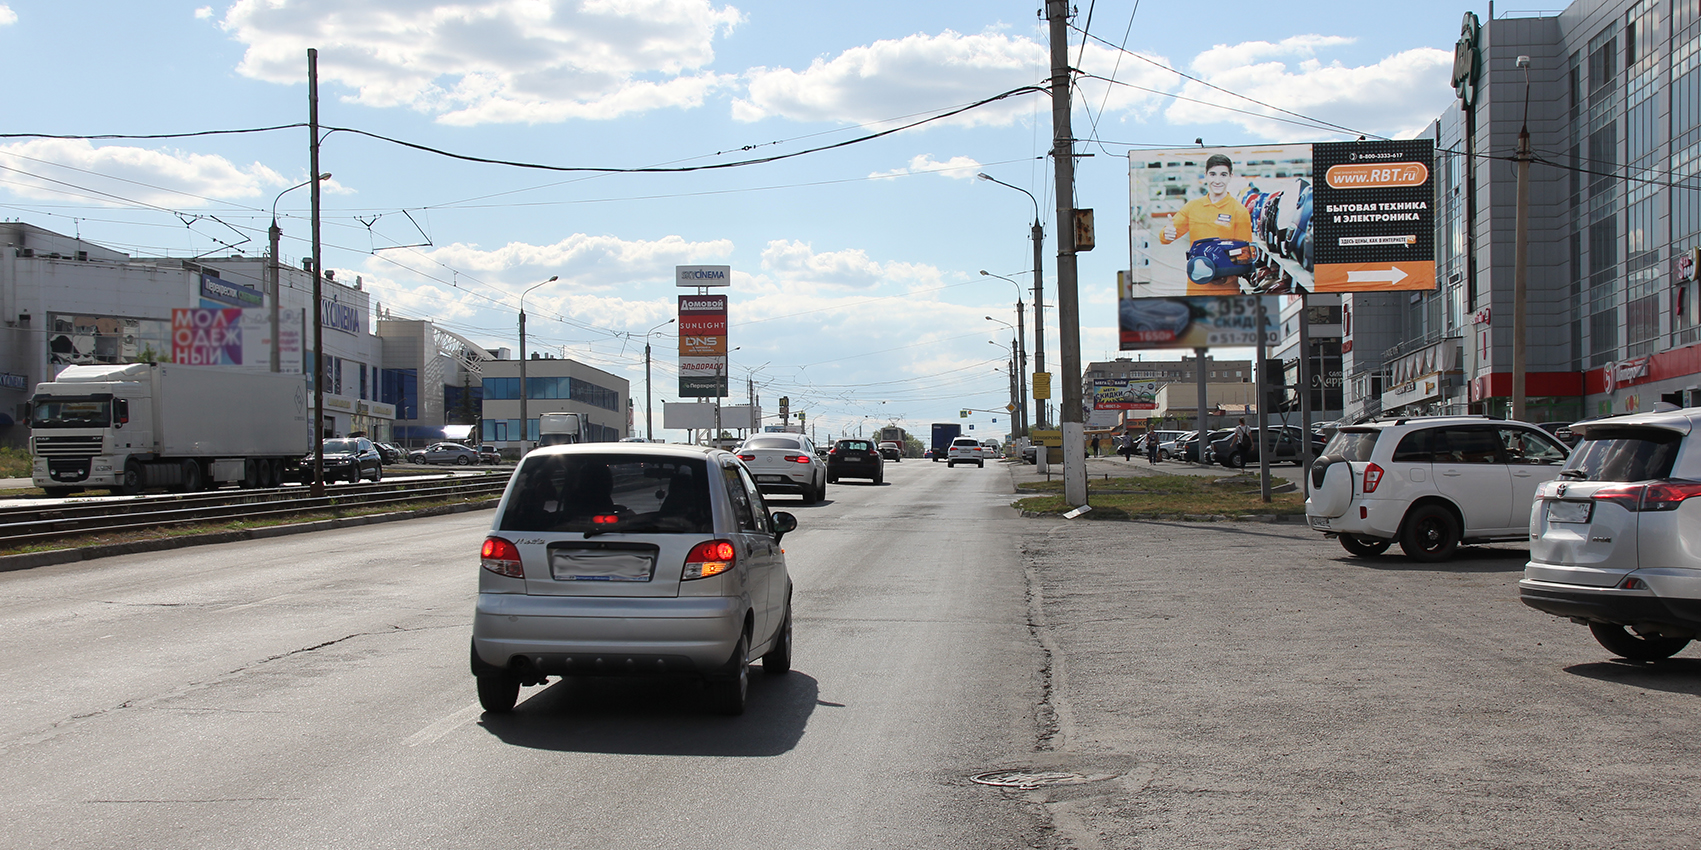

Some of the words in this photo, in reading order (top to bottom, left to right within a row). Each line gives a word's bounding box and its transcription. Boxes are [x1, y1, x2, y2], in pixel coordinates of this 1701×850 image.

[1358, 152, 1403, 160] 8-800-3333-617
[1333, 168, 1416, 184] www.RBT.ru
[1326, 203, 1377, 213] БЫТОВАЯ
[1378, 201, 1427, 211] ТЕХНИКА
[1333, 215, 1342, 223] И
[1342, 212, 1420, 222] ЭЛЕКТРОНИКА
[685, 336, 718, 346] DNS
[1095, 390, 1124, 401] СКИДКИ
